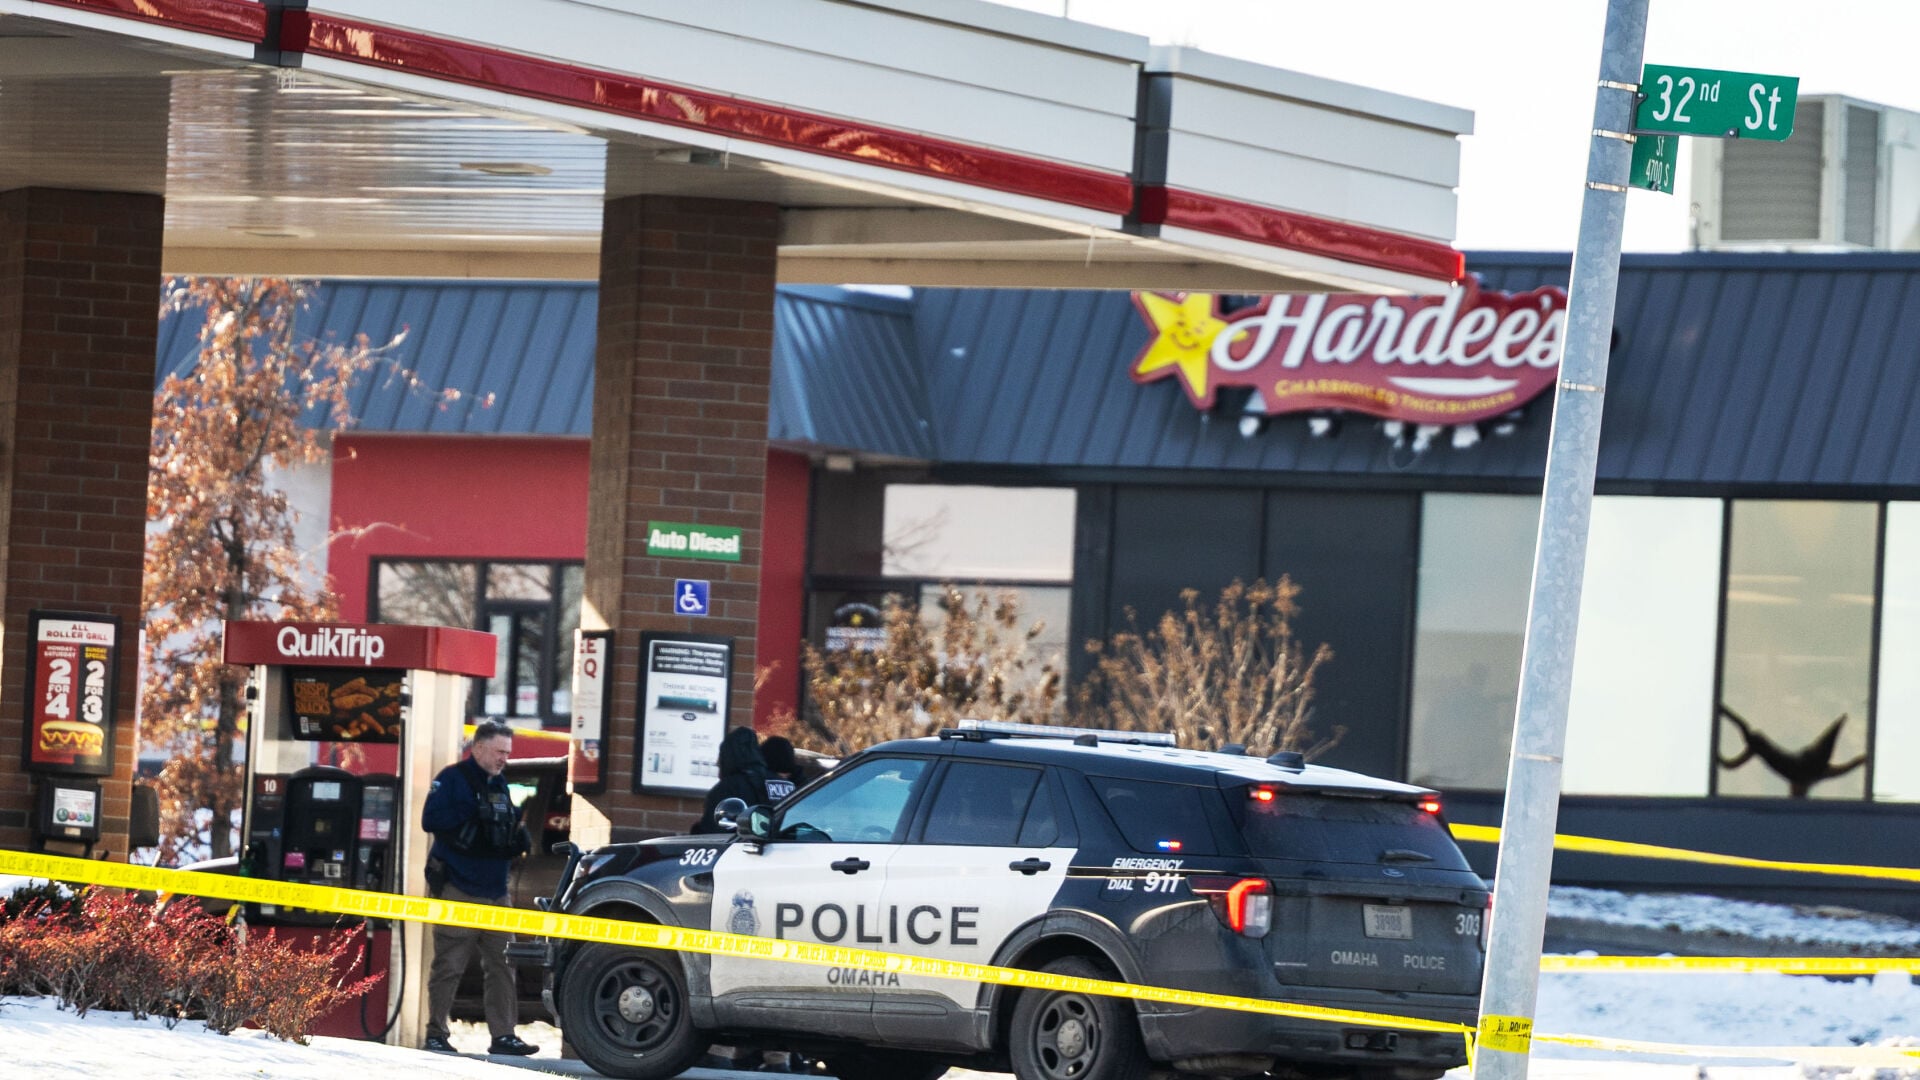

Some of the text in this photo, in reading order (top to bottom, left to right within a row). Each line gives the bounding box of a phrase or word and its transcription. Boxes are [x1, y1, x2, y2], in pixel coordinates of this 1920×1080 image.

[1652, 74, 1782, 131] 32nd St
[1656, 135, 1665, 157] St
[1663, 164, 1670, 187] S
[1211, 293, 1566, 371] Hardee's
[648, 529, 740, 556] Auto Diesel
[47, 631, 108, 641] ROLLER GRILL
[277, 626, 385, 665] QuikTrip
[49, 658, 71, 685] 2
[86, 660, 105, 687] 2
[48, 684, 70, 694] FOR
[84, 687, 104, 697] FOR
[264, 779, 277, 792] 10
[679, 849, 718, 866] 303
[1112, 858, 1183, 871] EMERGENCY
[1107, 872, 1180, 893] DIAL 911
[775, 903, 980, 946] POLICE
[1455, 913, 1481, 936] 303
[682, 932, 772, 957] POLICE LINE DO NOT CROSS
[797, 945, 886, 969] POLICE LINE DO NOT CROSS
[1331, 950, 1445, 971] OMAHA POLICE
[827, 967, 900, 987] OMAHA
